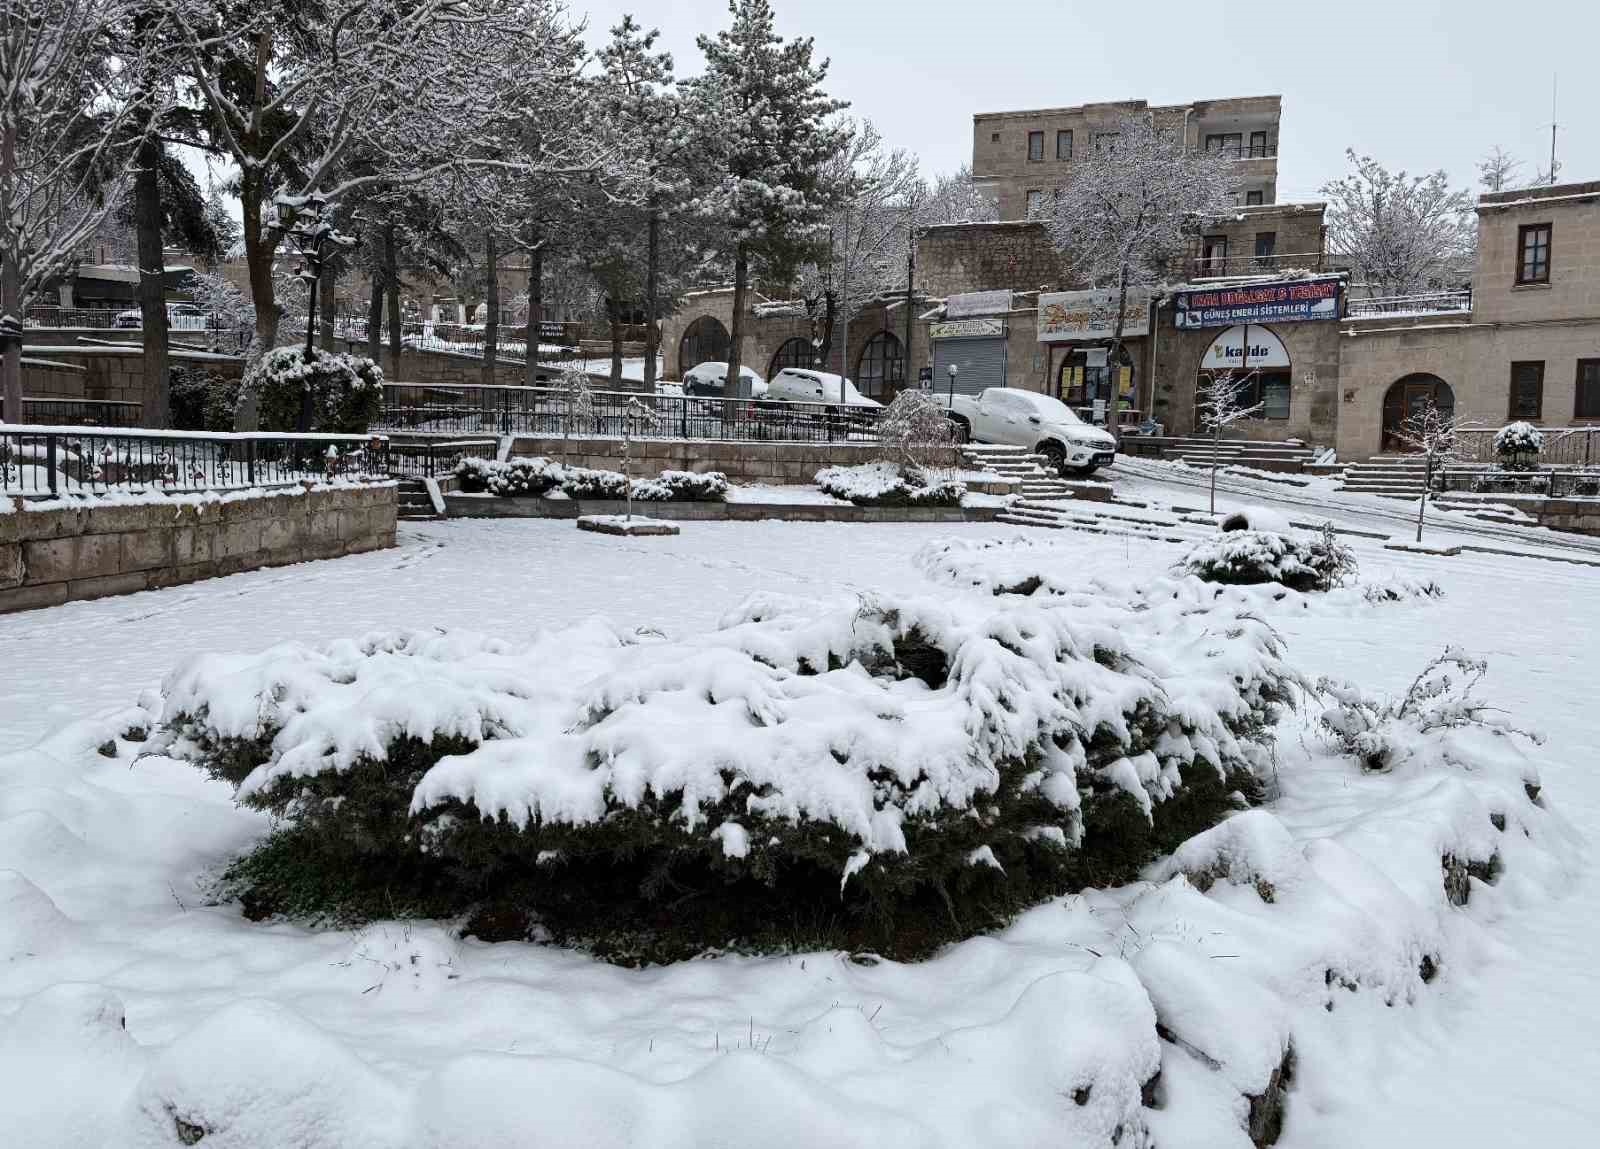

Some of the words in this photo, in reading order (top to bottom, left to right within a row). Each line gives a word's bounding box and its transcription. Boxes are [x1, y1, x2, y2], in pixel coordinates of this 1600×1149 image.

[1203, 308, 1230, 320] GÜNEŞ
[1232, 305, 1259, 318] ENERJİ
[1260, 301, 1310, 316] SİSTEMLERİ
[1225, 344, 1269, 358] kalde
